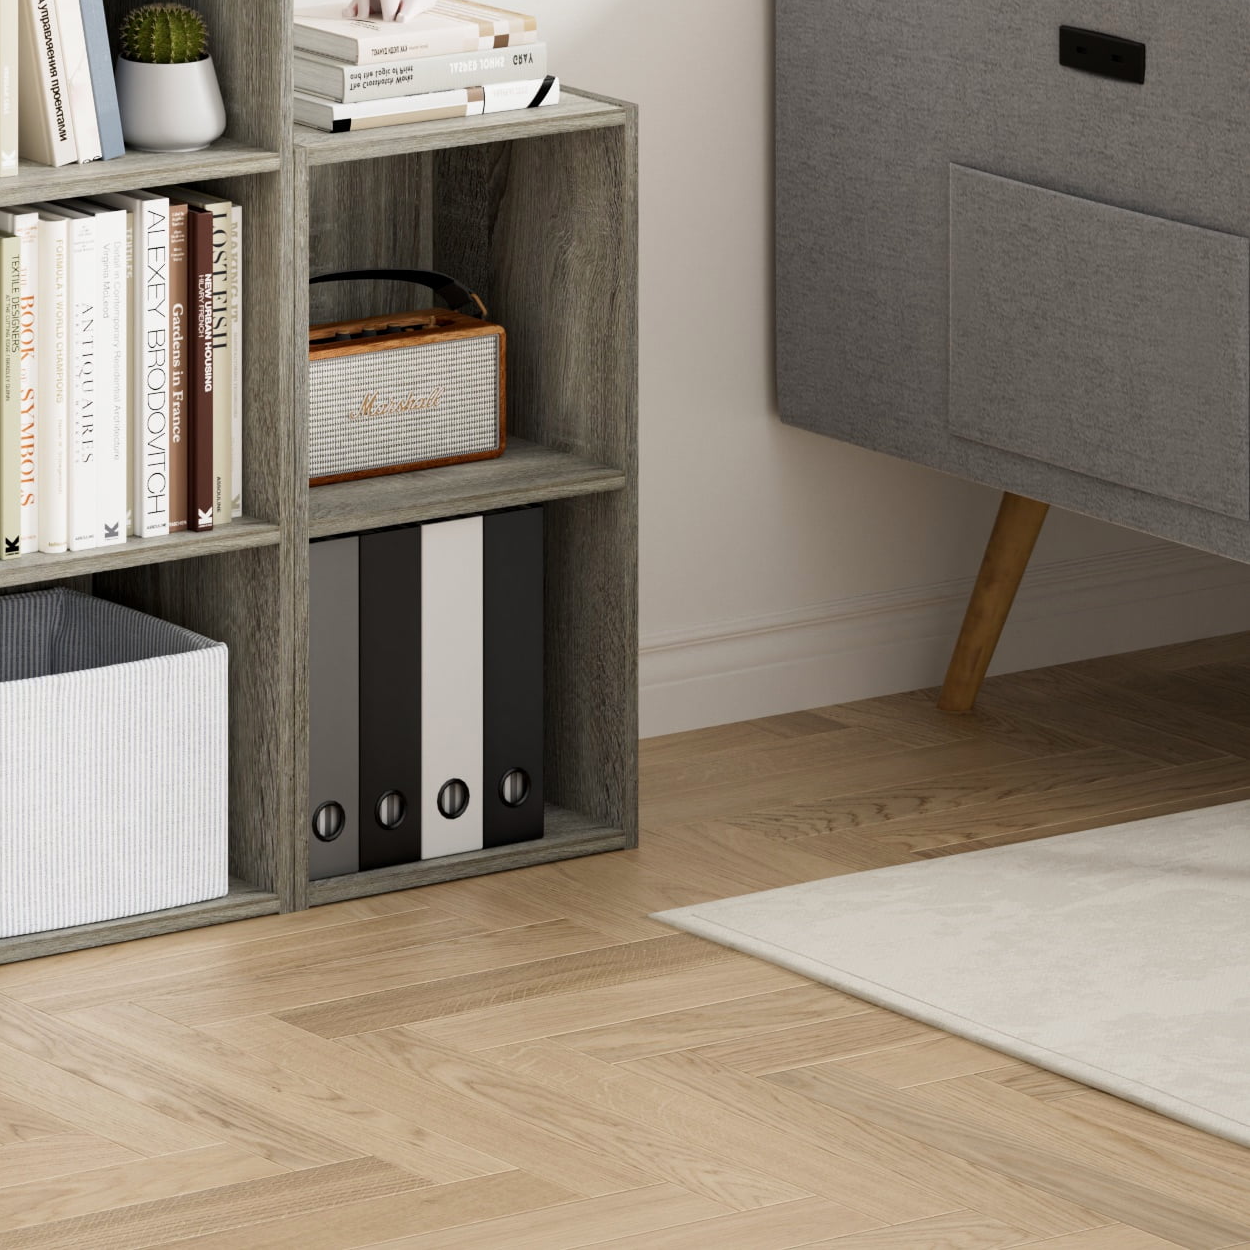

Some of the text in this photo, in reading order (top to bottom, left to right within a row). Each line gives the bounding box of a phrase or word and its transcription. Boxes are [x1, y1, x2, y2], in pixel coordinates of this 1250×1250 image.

[38, 2, 58, 78] управления
[50, 78, 68, 142] проектами
[11, 254, 20, 353] TEXTILE DESIGNERS
[55, 239, 64, 291] FORMULA
[55, 301, 64, 339] WORLD
[55, 341, 64, 404] CHAMPIONS
[80, 303, 94, 463] ANTIQUAIRES
[147, 210, 166, 515] ALEXEY BRODOVITCH
[172, 303, 184, 443] Gardens in France
[204, 273, 213, 393] NEW URBAN HOUSING
[20, 295, 34, 507] BOOK SYMBOLS
[350, 387, 446, 419] Marshall
